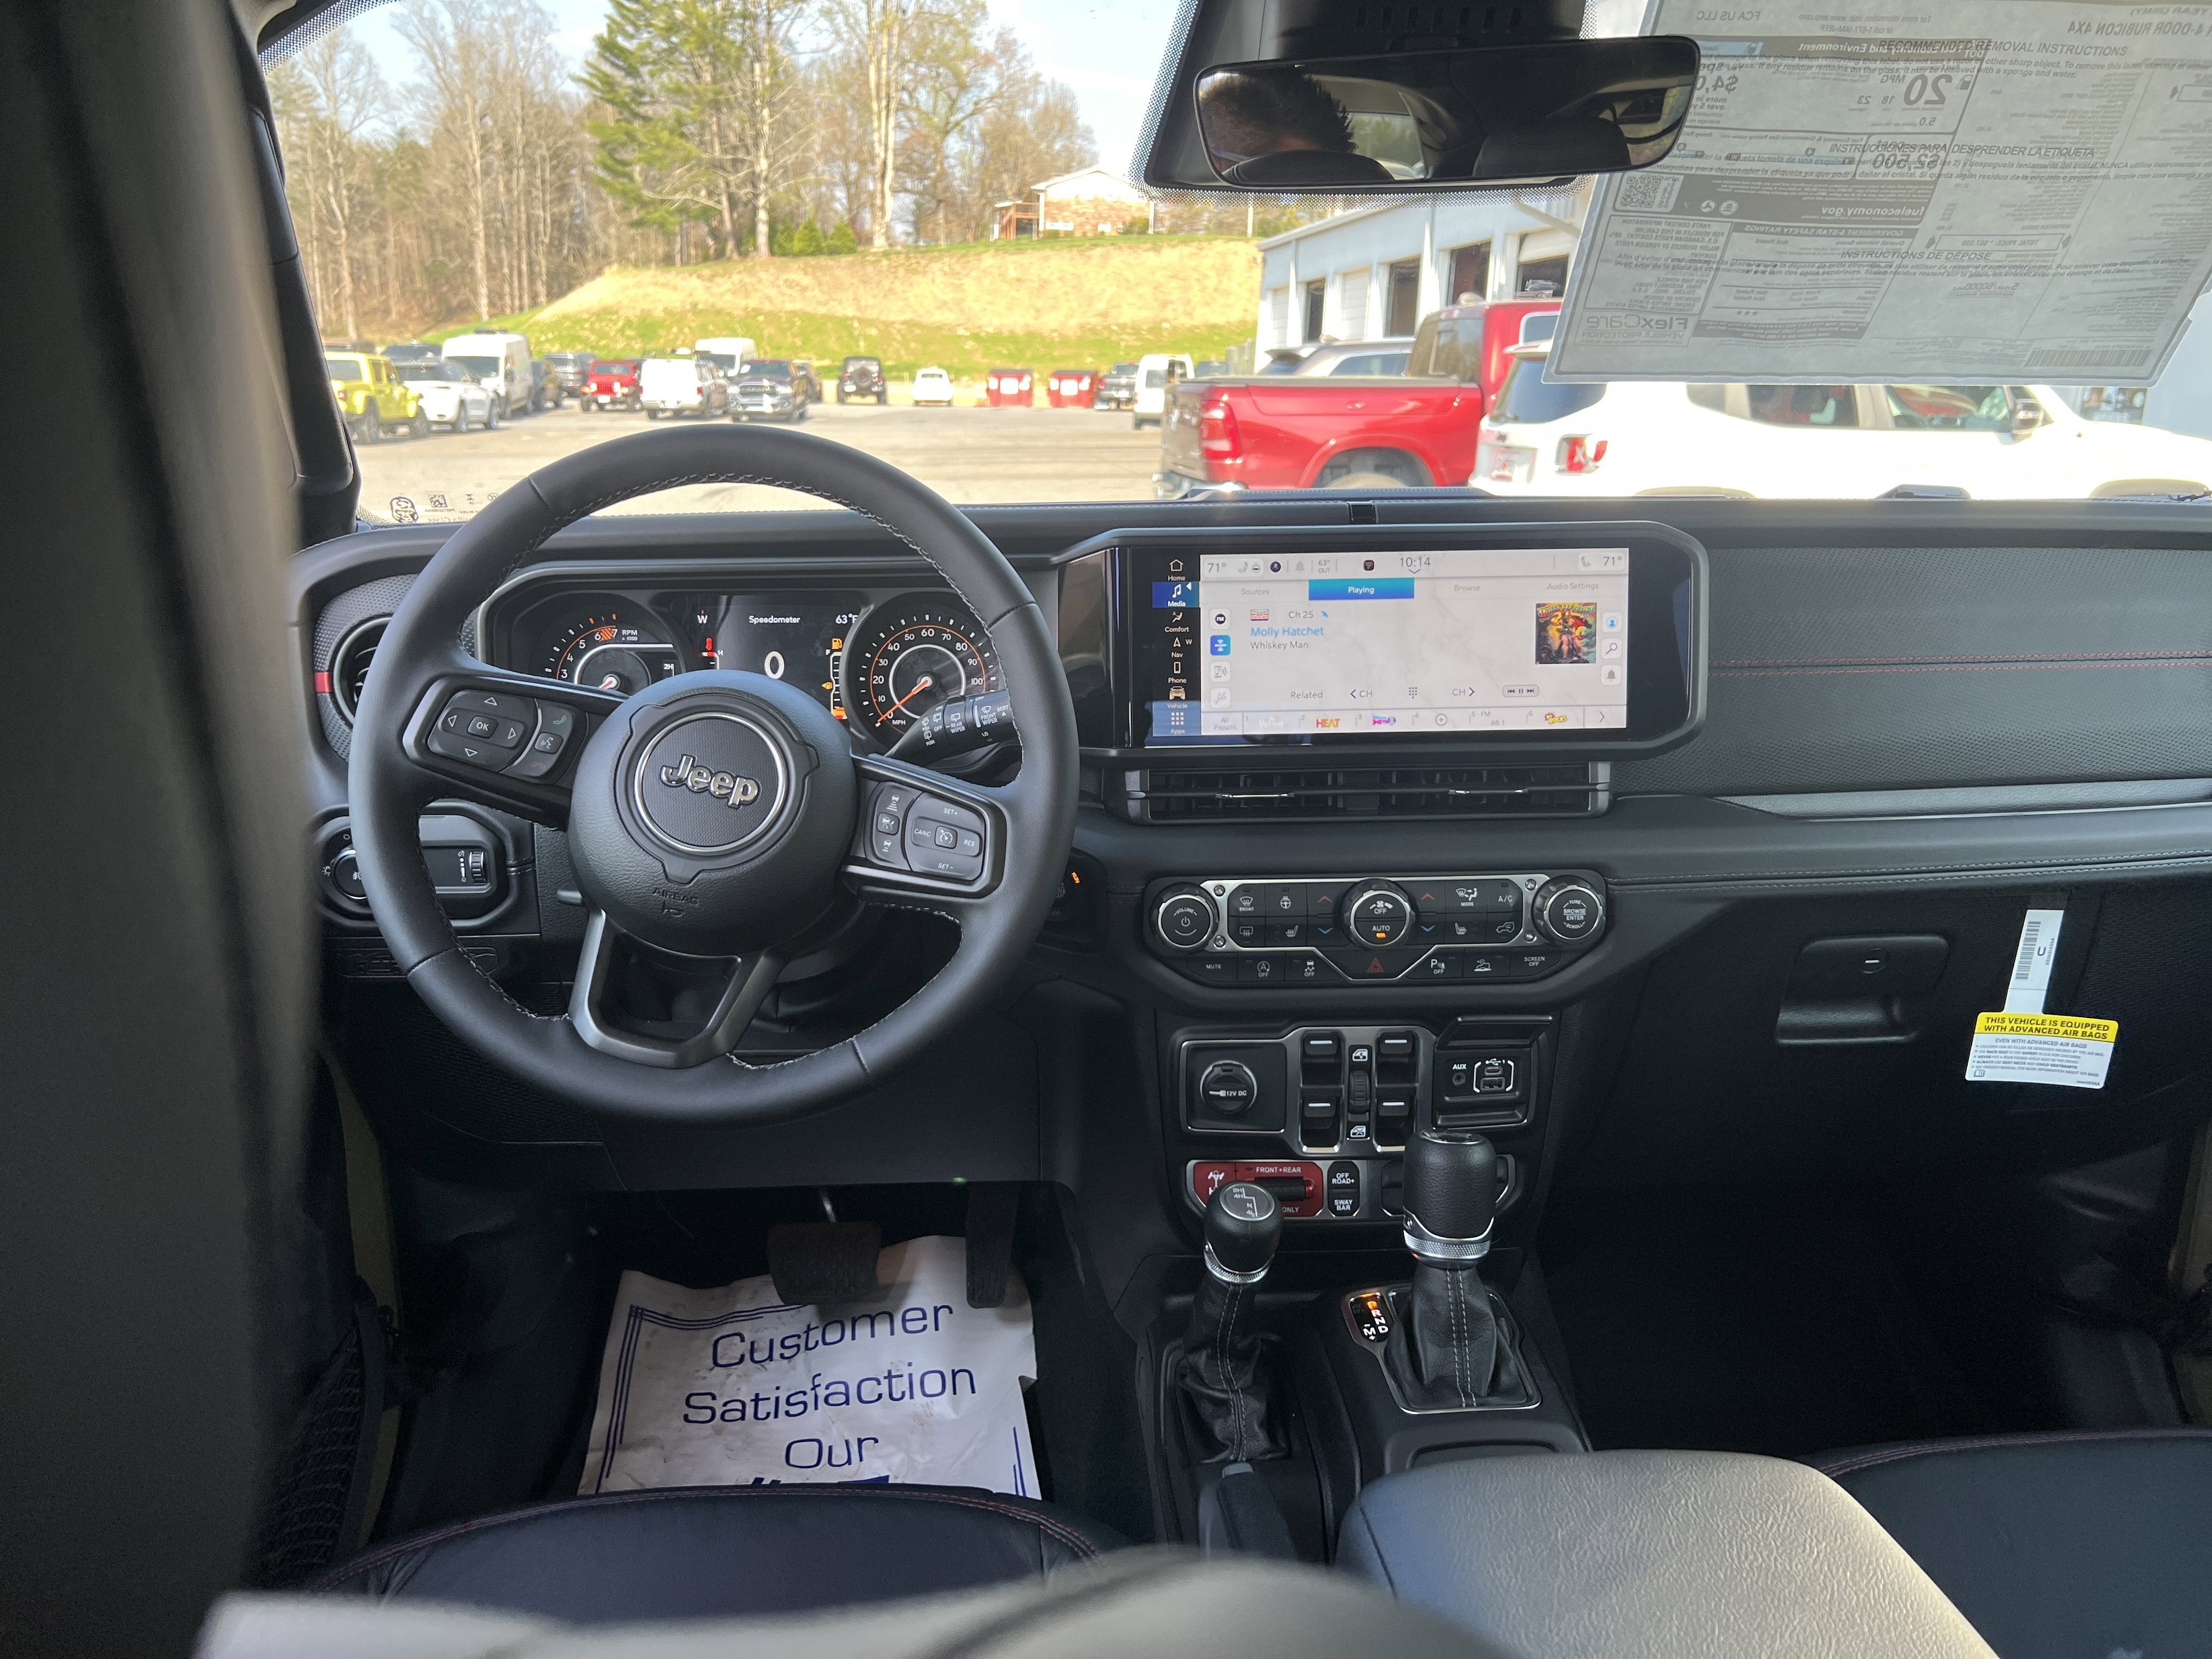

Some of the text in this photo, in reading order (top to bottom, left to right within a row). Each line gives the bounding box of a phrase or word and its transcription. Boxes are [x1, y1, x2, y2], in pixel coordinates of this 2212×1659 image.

[1878, 39, 2129, 57] RECOMMENDED REMOVAL INSTRUCTIONS
[2009, 59, 2062, 68] sharp object.
[2002, 69, 2033, 77] sponge
[1951, 144, 2096, 159] DESPRENDER ETIQUETA
[1841, 250, 1926, 260] INSTRUCTIONS
[1926, 252, 1941, 260] DE
[1399, 556, 1431, 568] 10:14
[1602, 555, 1623, 567] 71°
[1241, 587, 1270, 595] Sources
[1347, 585, 1375, 595] Playing
[1547, 582, 1599, 591] Audio Settings
[697, 615, 708, 624] W
[836, 613, 858, 624] 63°F
[1288, 611, 1314, 619] Ch 25
[749, 615, 800, 625] Speedometer
[611, 629, 618, 638] 7
[921, 628, 935, 637] 60
[1164, 625, 1189, 634] Comfort
[1250, 626, 1324, 638] Molly Hatchet
[594, 632, 601, 641] 6
[579, 640, 586, 649] 5
[888, 642, 900, 652] 40
[955, 642, 968, 652] 80
[1250, 641, 1309, 651] Whiskey Man
[567, 652, 574, 662] 4
[764, 651, 785, 680] 0
[878, 658, 888, 667] 30
[968, 658, 978, 667] 90
[561, 669, 569, 679] 3
[872, 676, 884, 685] 20
[970, 678, 984, 686] 100
[1290, 690, 1323, 699] Related
[1359, 690, 1373, 698] CH
[1452, 688, 1466, 697] CH
[887, 712, 894, 720] 0
[980, 713, 996, 721] FRONT
[982, 716, 998, 725] WIPER
[476, 721, 489, 731] OK
[1316, 718, 1340, 729] HEAT
[950, 725, 966, 734] WIPER
[1170, 728, 1186, 736] Apps
[661, 754, 760, 808] Jeep
[914, 828, 932, 837] CANC
[963, 839, 975, 847] RES
[652, 887, 701, 906] AIRBAG
[1497, 895, 1513, 903] A/C
[2038, 946, 2046, 957] U
[1430, 959, 1438, 968] P
[1986, 1017, 2006, 1025] THIS
[2008, 1017, 2046, 1026] VEHICLE
[2060, 1020, 2110, 1032] EQUIPPED
[2008, 1025, 2061, 1035] ADVANCED
[2081, 1030, 2108, 1040] BAGS
[1367, 1301, 1378, 1310] P
[1371, 1309, 1382, 1317] R
[1374, 1317, 1386, 1325] N
[1363, 1327, 1376, 1336] M
[1378, 1325, 1389, 1334] D
[712, 1304, 953, 1368] Customer
[682, 1361, 977, 1425] Satisfaction
[785, 1435, 879, 1469] Our
